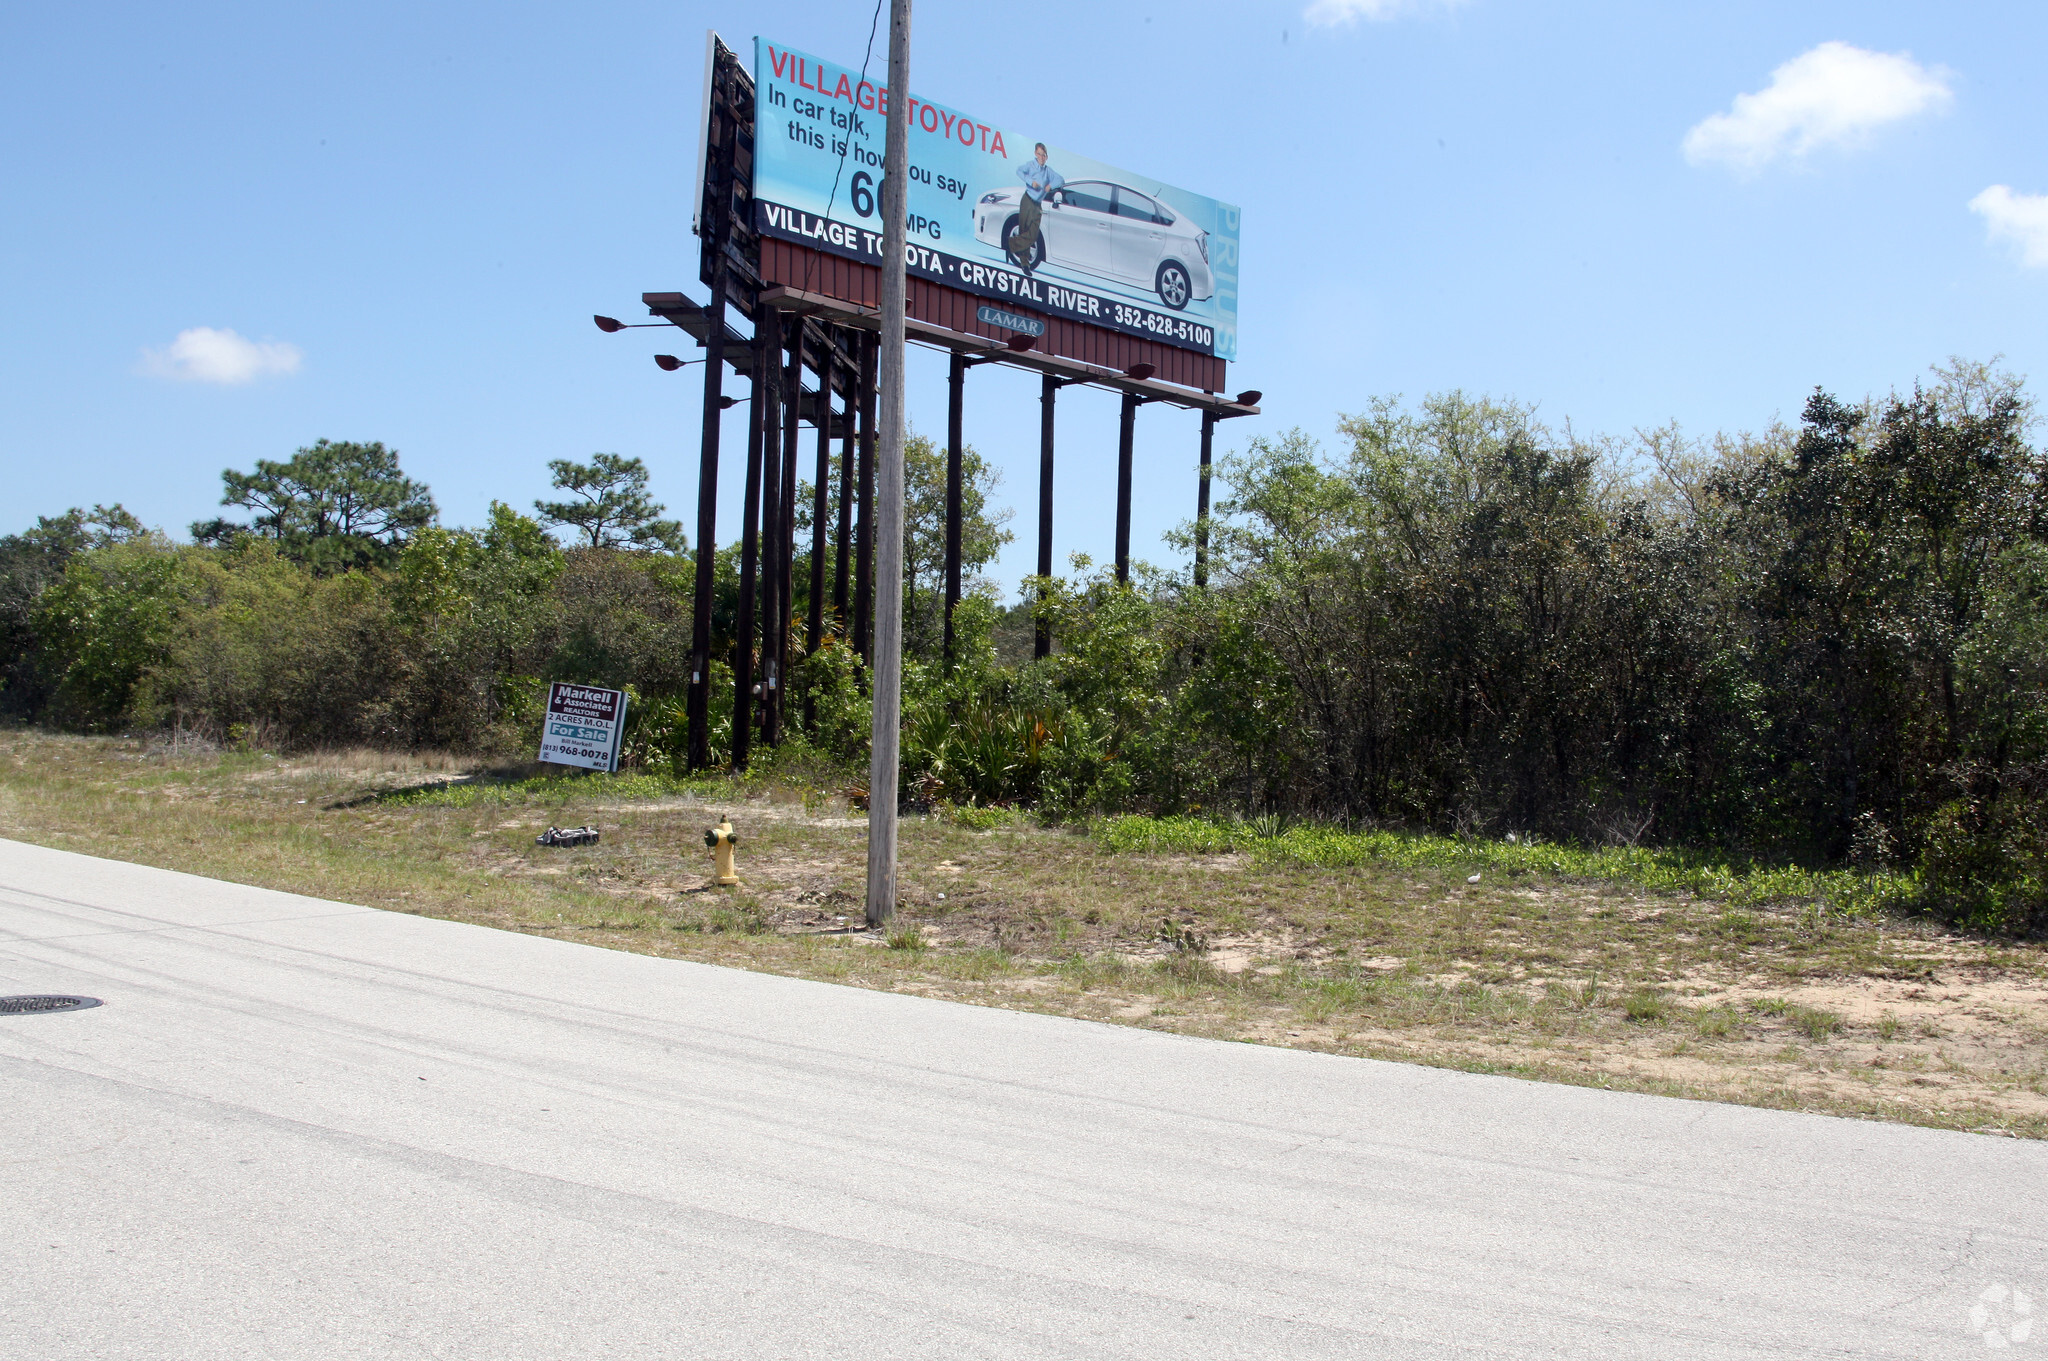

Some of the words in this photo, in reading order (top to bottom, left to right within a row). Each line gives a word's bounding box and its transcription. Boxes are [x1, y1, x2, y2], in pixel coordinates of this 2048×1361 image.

[768, 46, 888, 117] VILLAGE
[908, 98, 1007, 159] TOYOTA
[768, 83, 786, 108] In
[793, 97, 824, 120] car
[830, 106, 870, 140] talk,
[788, 120, 825, 150] this
[831, 134, 847, 157] is
[908, 165, 931, 185] ou
[937, 175, 967, 201] say
[851, 171, 885, 221] 6
[906, 213, 941, 240] MPG
[765, 203, 858, 250] VILLAGE
[863, 232, 943, 275] TOOTA
[959, 262, 1042, 302] CRYSTAL
[1049, 286, 1100, 318] RIVER
[1115, 304, 1212, 347] 352-628-5100
[1215, 200, 1239, 353] PRIUS
[983, 309, 1038, 335] LAMAR
[554, 696, 561, 704] &
[564, 698, 612, 712] Associates
[558, 686, 612, 703] Markell
[555, 715, 582, 725] ACRES
[584, 718, 613, 730] M.O.L.
[563, 707, 600, 718] REALTORS
[551, 724, 574, 736] For
[577, 728, 607, 741] Sale
[543, 744, 558, 752] (813)
[559, 746, 608, 760] 968-0078
